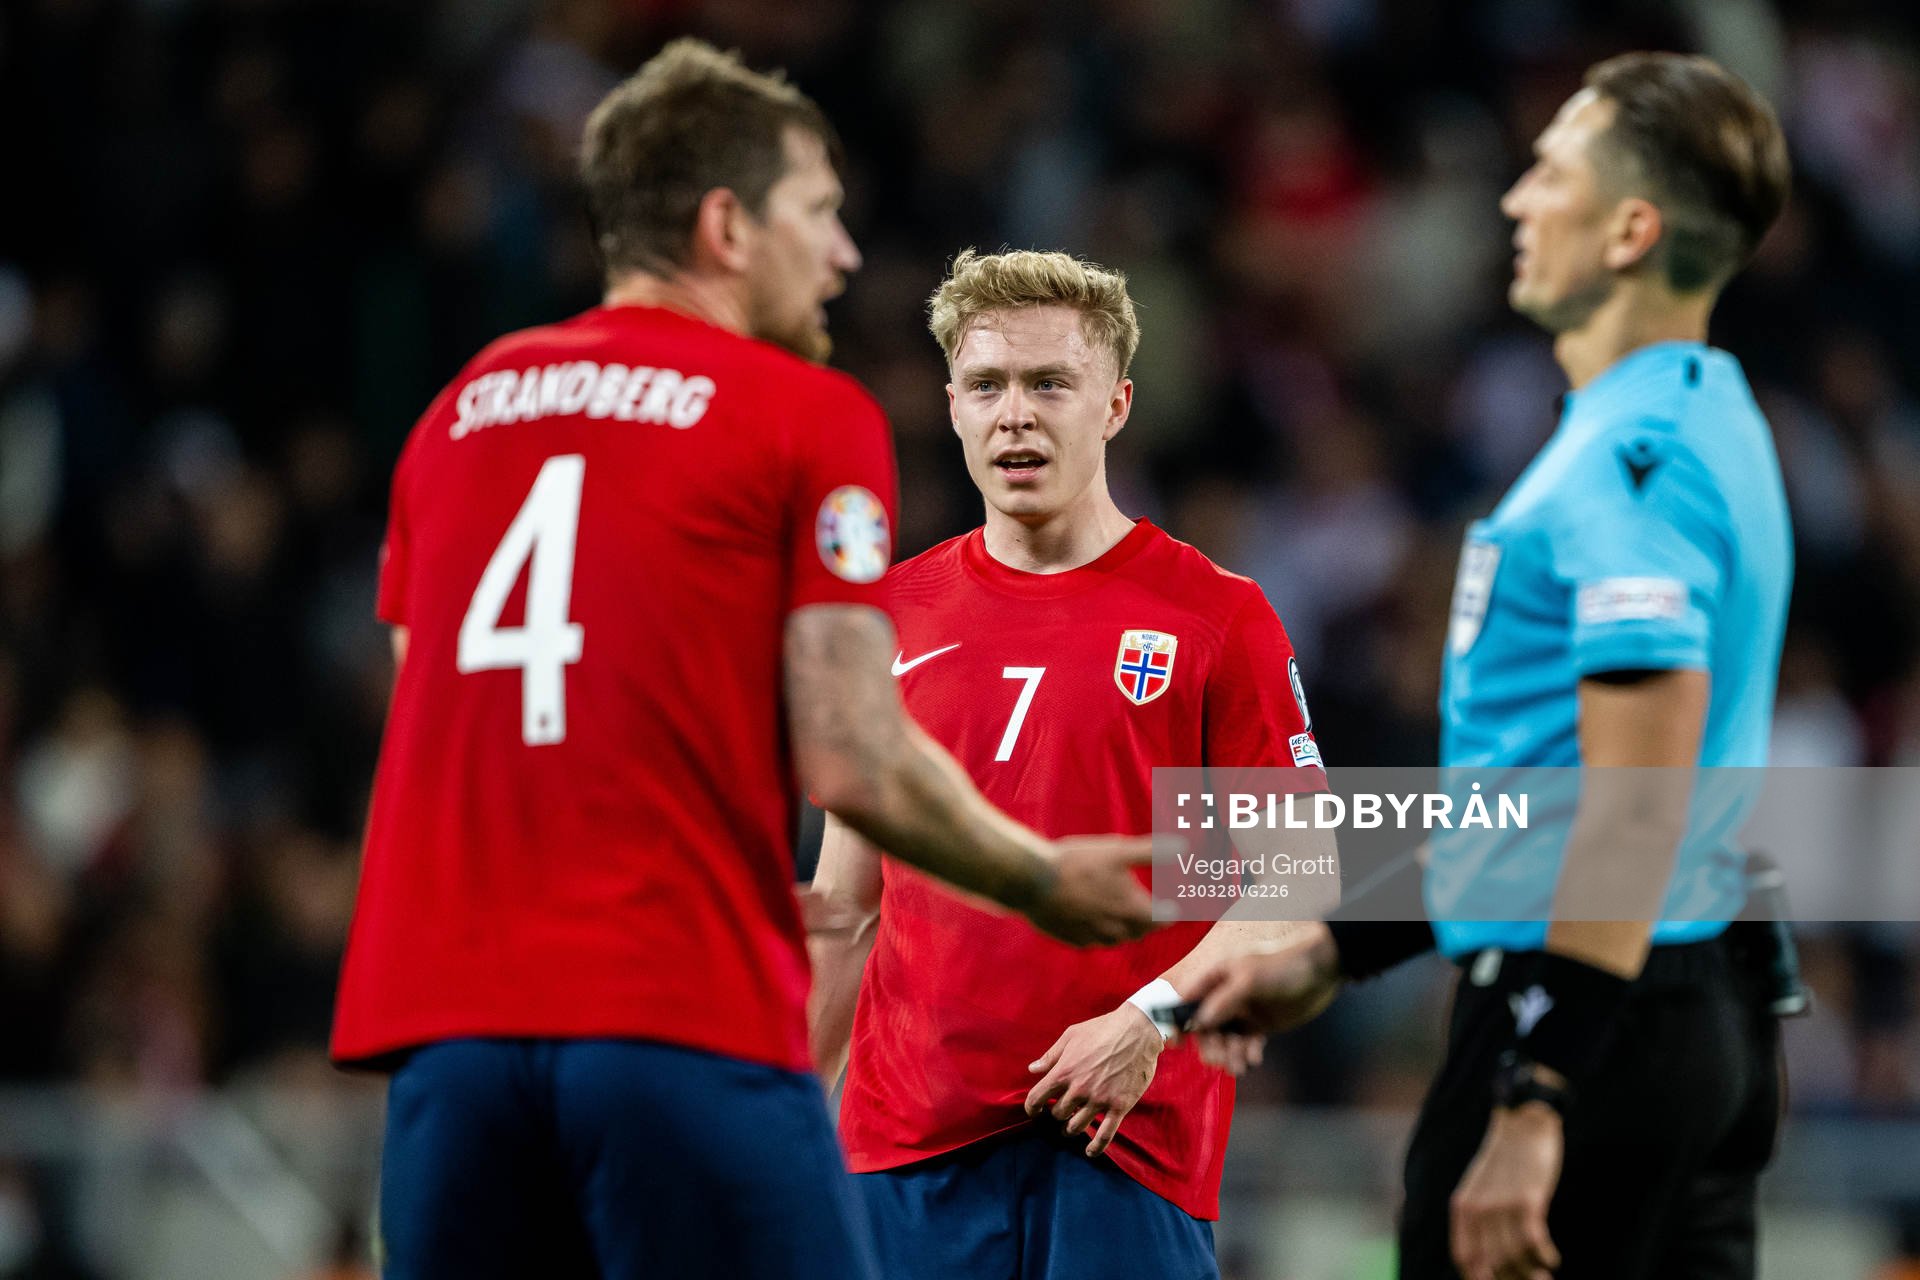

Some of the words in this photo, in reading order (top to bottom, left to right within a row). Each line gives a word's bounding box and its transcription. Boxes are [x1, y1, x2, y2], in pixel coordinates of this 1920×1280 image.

[449, 360, 716, 441] STRANDBERG
[457, 453, 586, 746] 4
[994, 666, 1047, 762] 7
[1291, 735, 1310, 746] UEF
